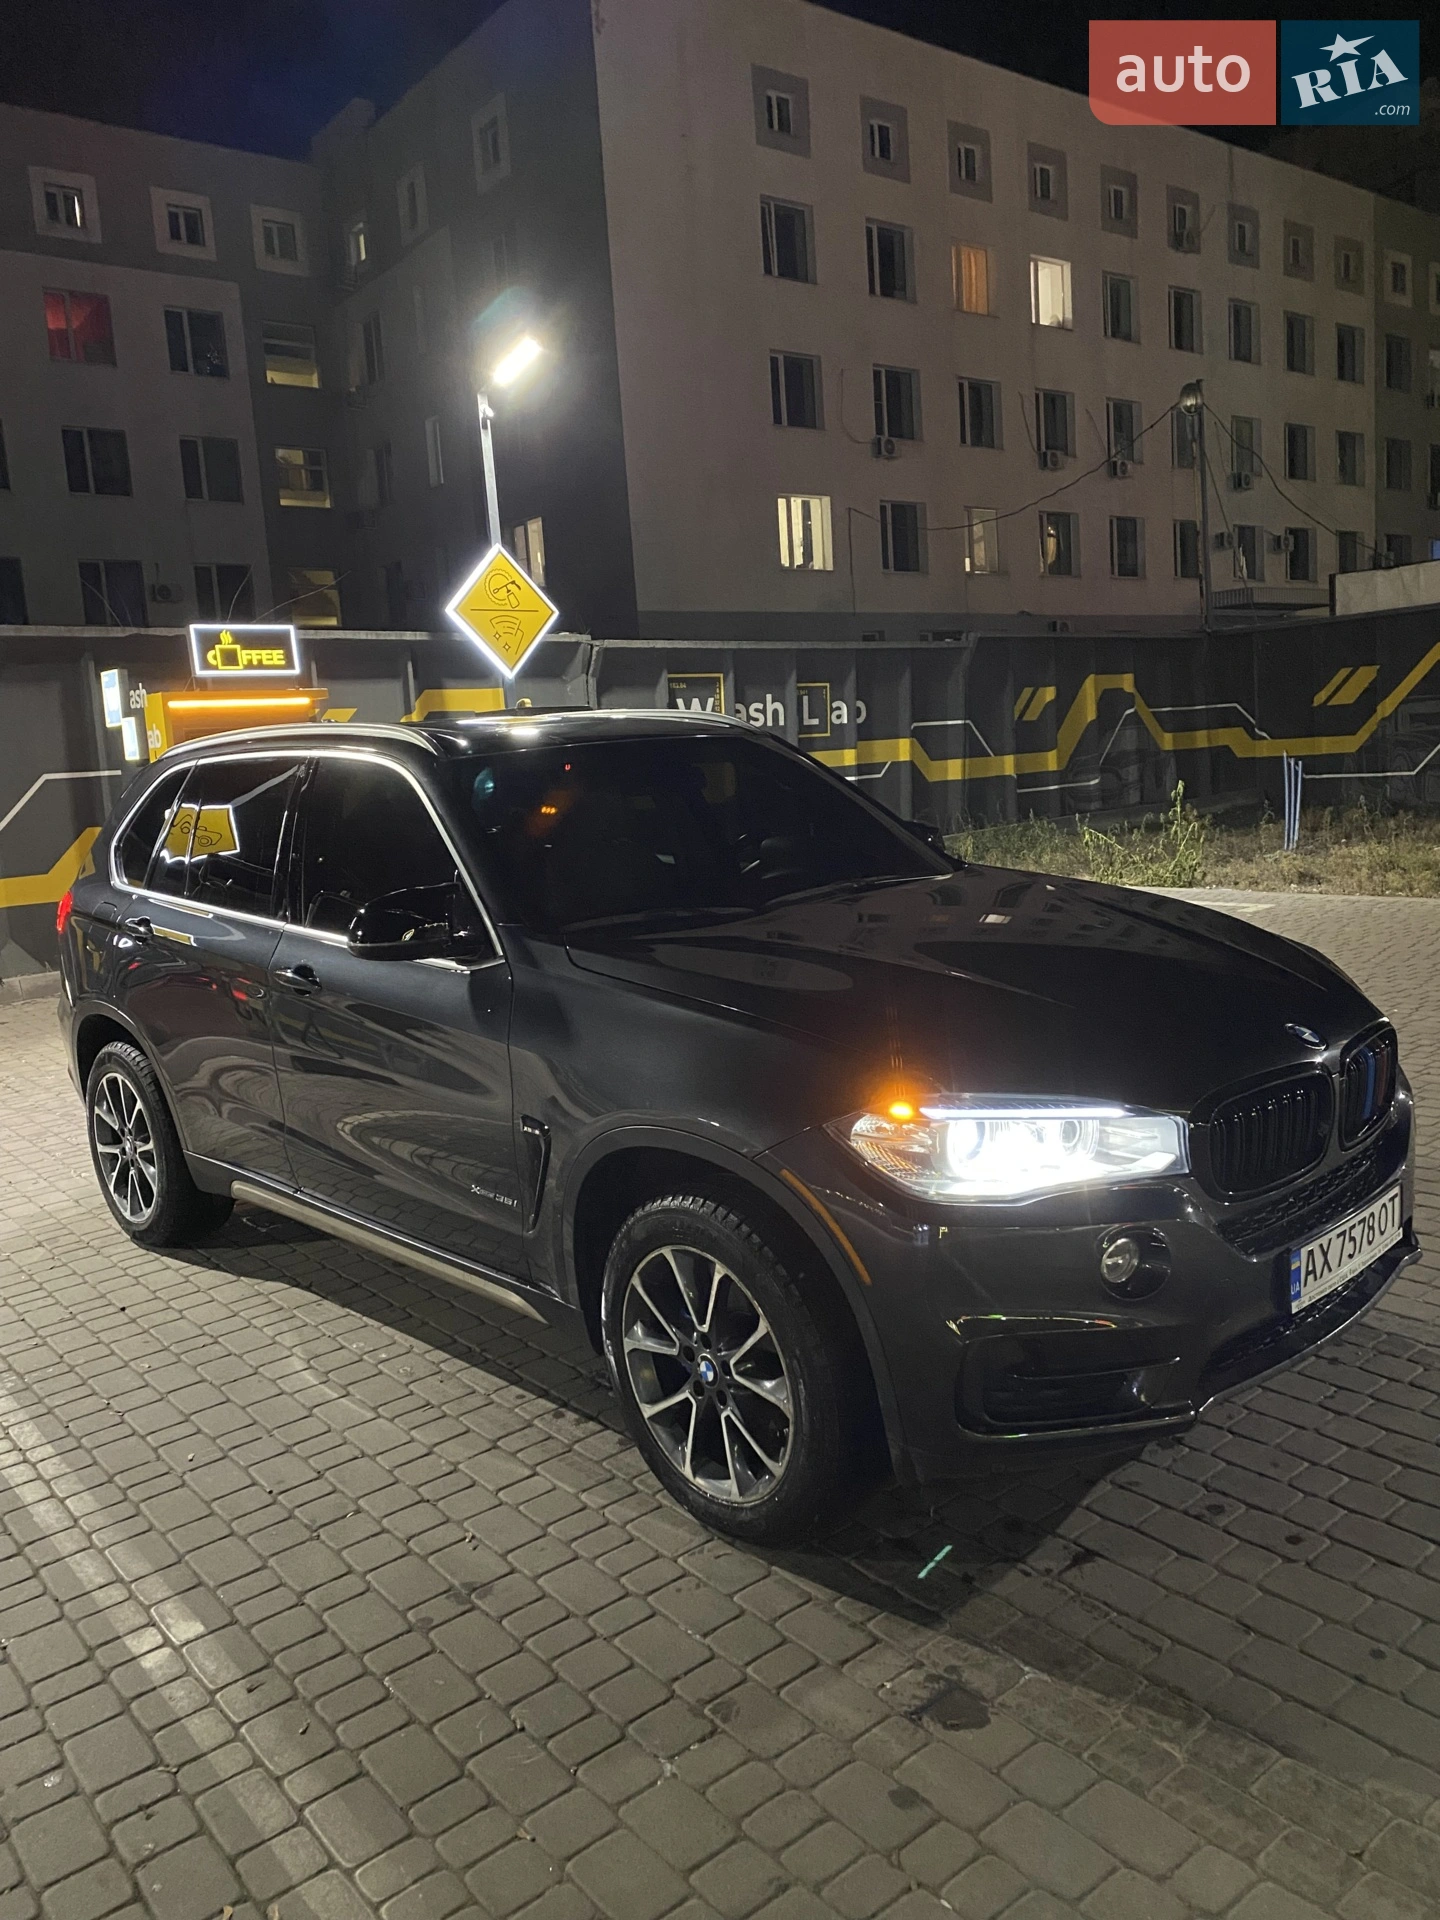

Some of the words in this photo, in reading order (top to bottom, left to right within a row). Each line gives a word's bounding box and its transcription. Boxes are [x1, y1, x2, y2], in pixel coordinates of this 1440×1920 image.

[1303, 1237, 1332, 1288] AX
[1336, 1211, 1375, 1268] 7578
[1378, 1193, 1399, 1237] OT
[1290, 1281, 1300, 1295] UA
